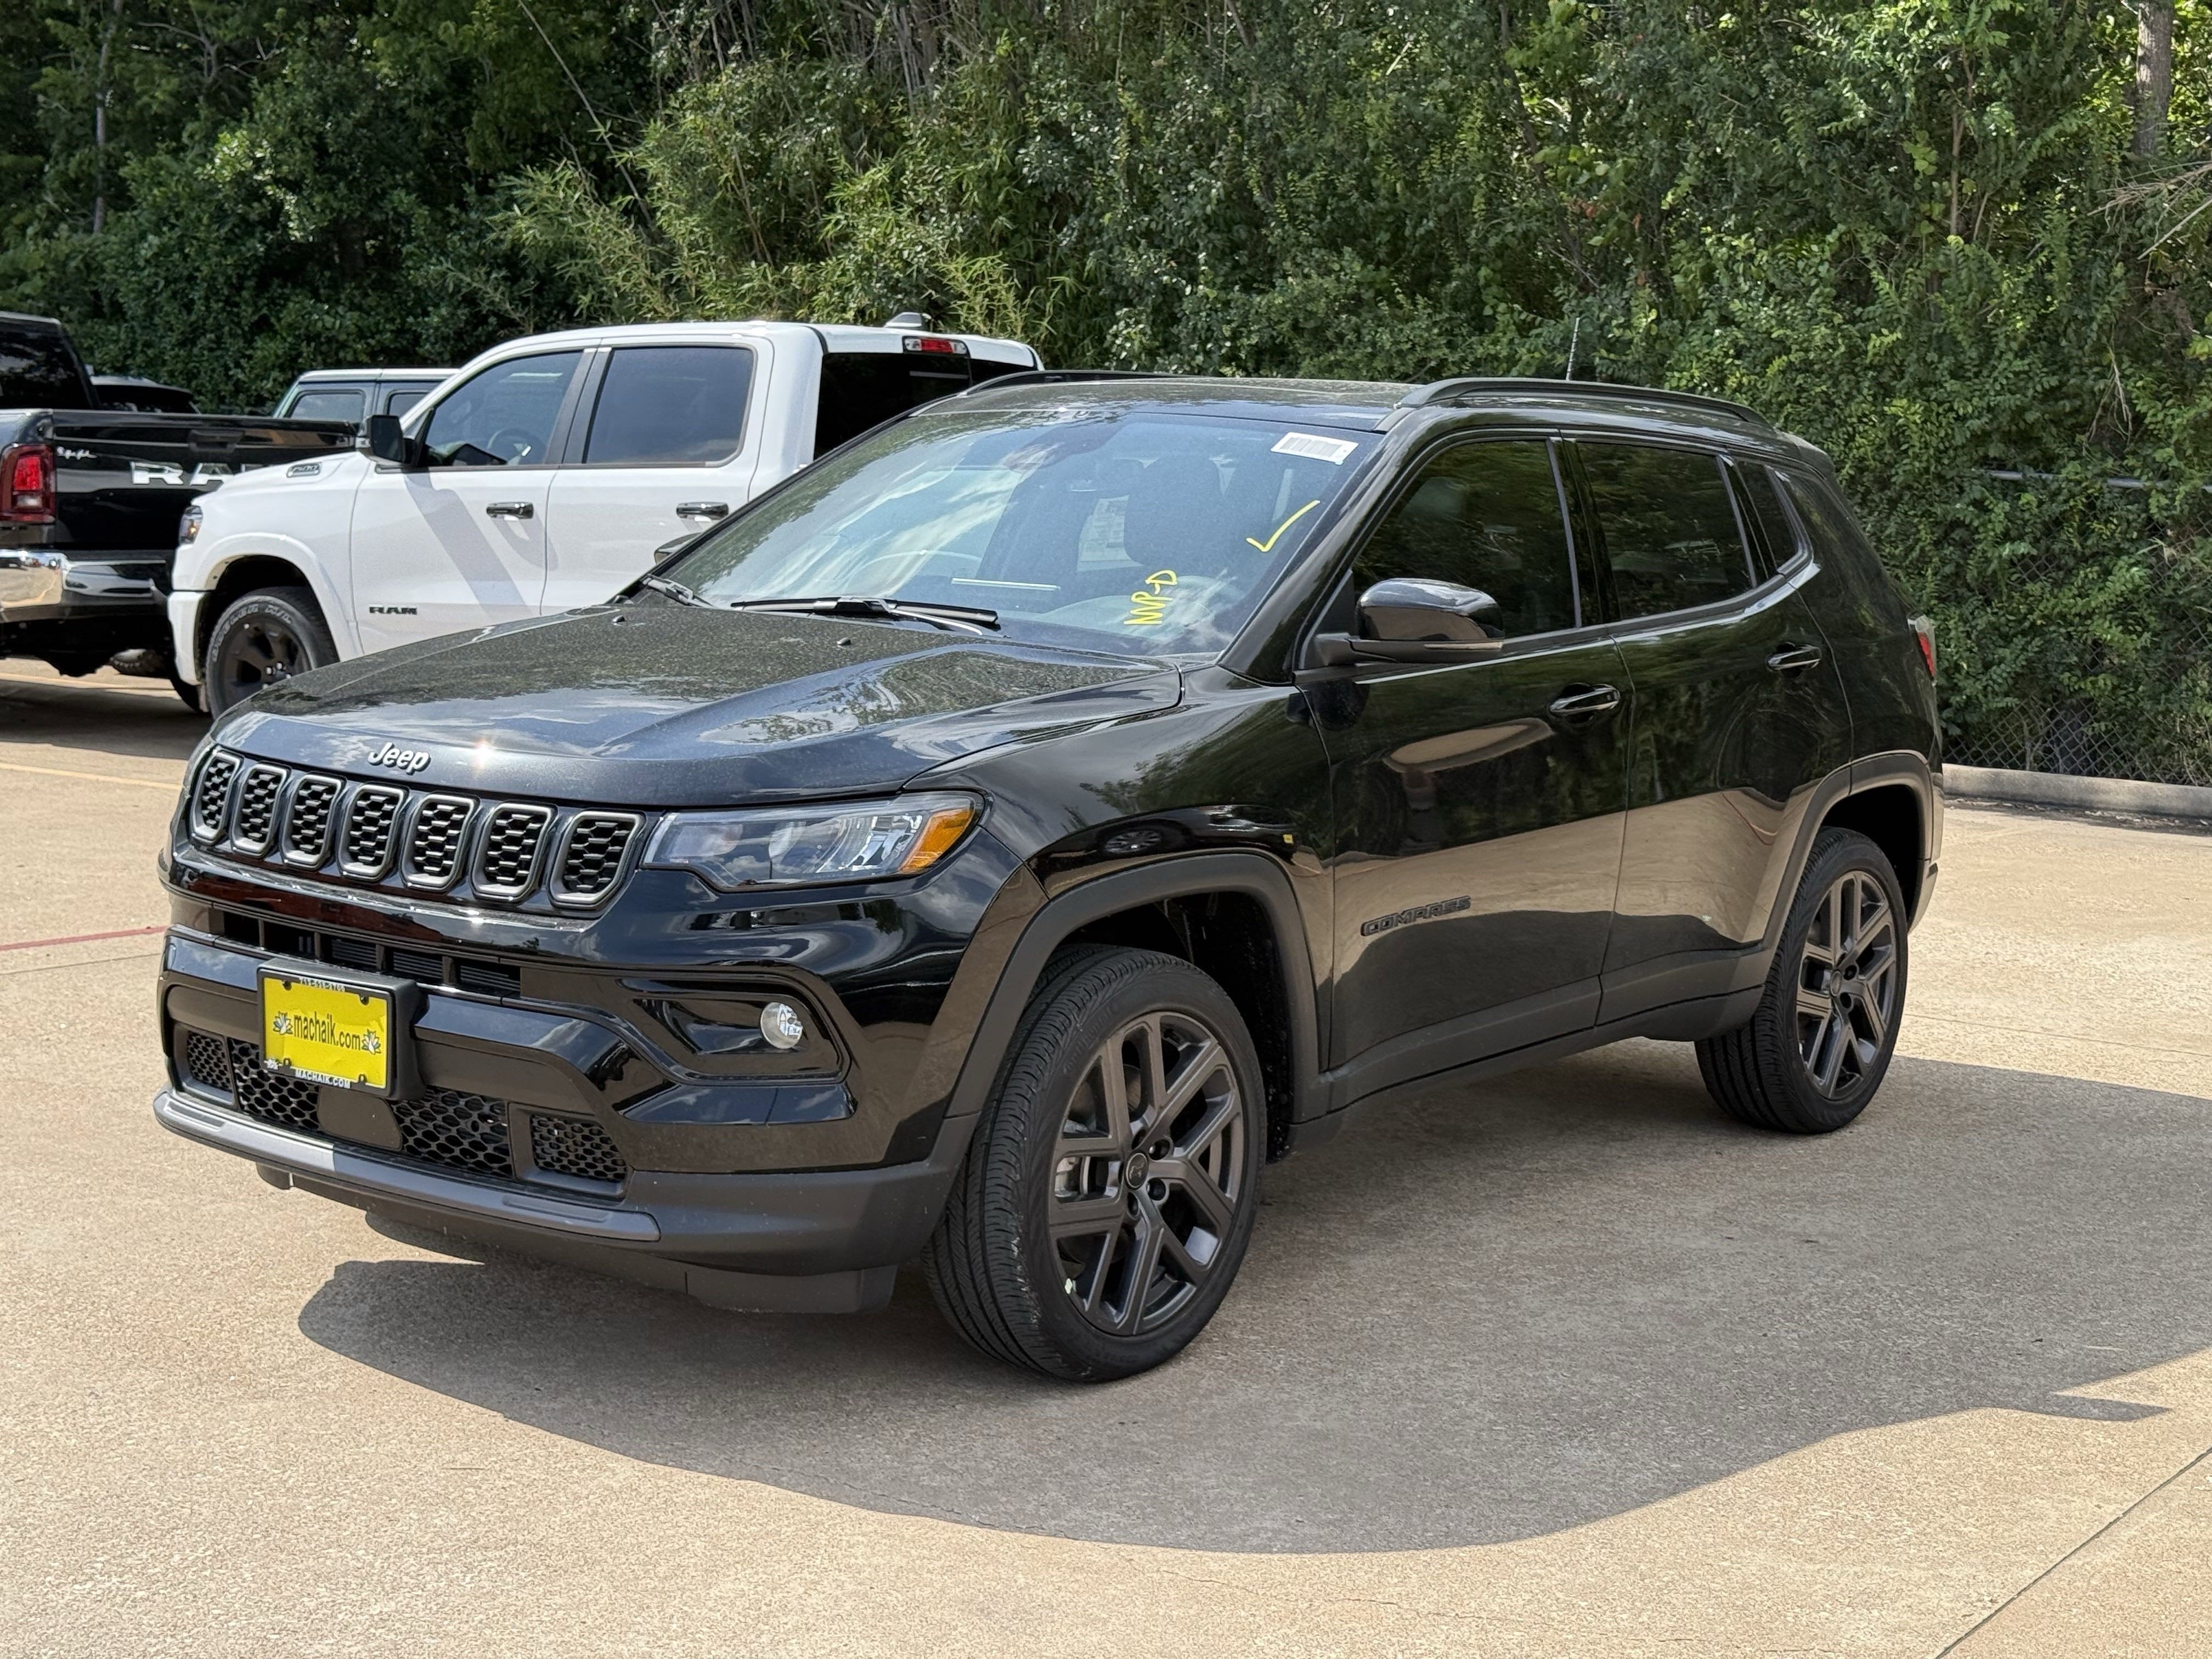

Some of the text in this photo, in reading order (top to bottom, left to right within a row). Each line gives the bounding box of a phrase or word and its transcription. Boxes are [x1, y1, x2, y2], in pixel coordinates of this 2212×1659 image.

[130, 461, 264, 486] RA
[369, 606, 417, 615] RAM
[368, 742, 431, 775] Jeep
[1361, 895, 1471, 936] COMPASS
[293, 1011, 361, 1051] machaik.com
[295, 1069, 351, 1089] MACHAIK.COM
